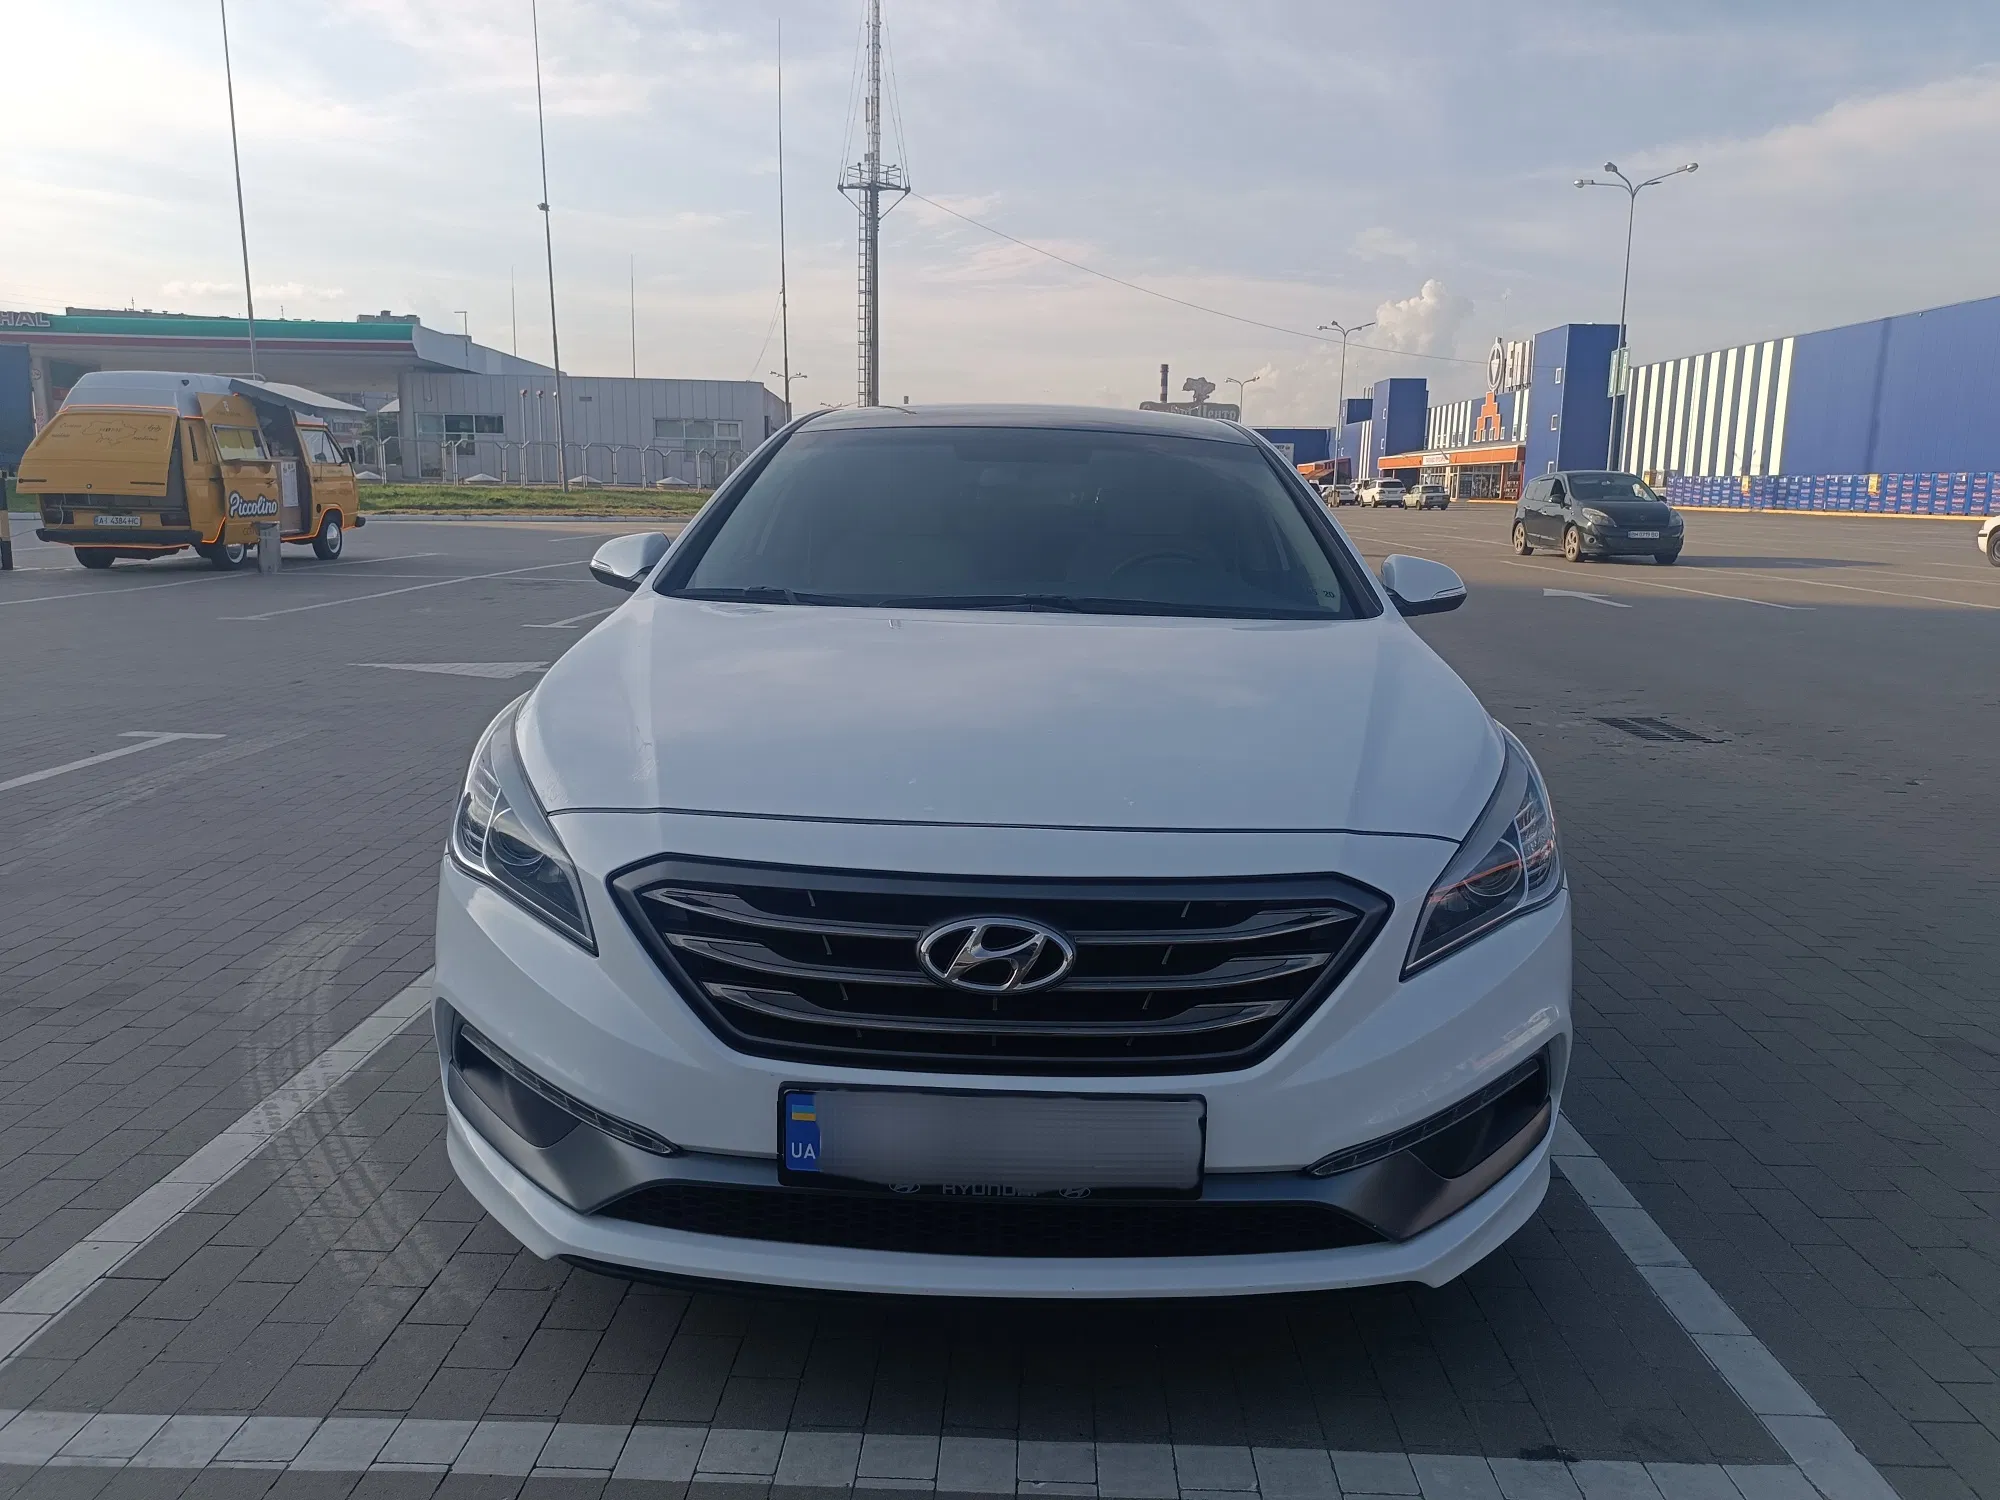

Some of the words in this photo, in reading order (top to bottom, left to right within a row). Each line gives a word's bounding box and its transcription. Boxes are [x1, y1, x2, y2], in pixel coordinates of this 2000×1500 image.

[230, 491, 278, 517] Piccolino
[110, 517, 127, 525] 4384
[791, 1142, 816, 1160] UA
[942, 1183, 1038, 1197] HYUND
